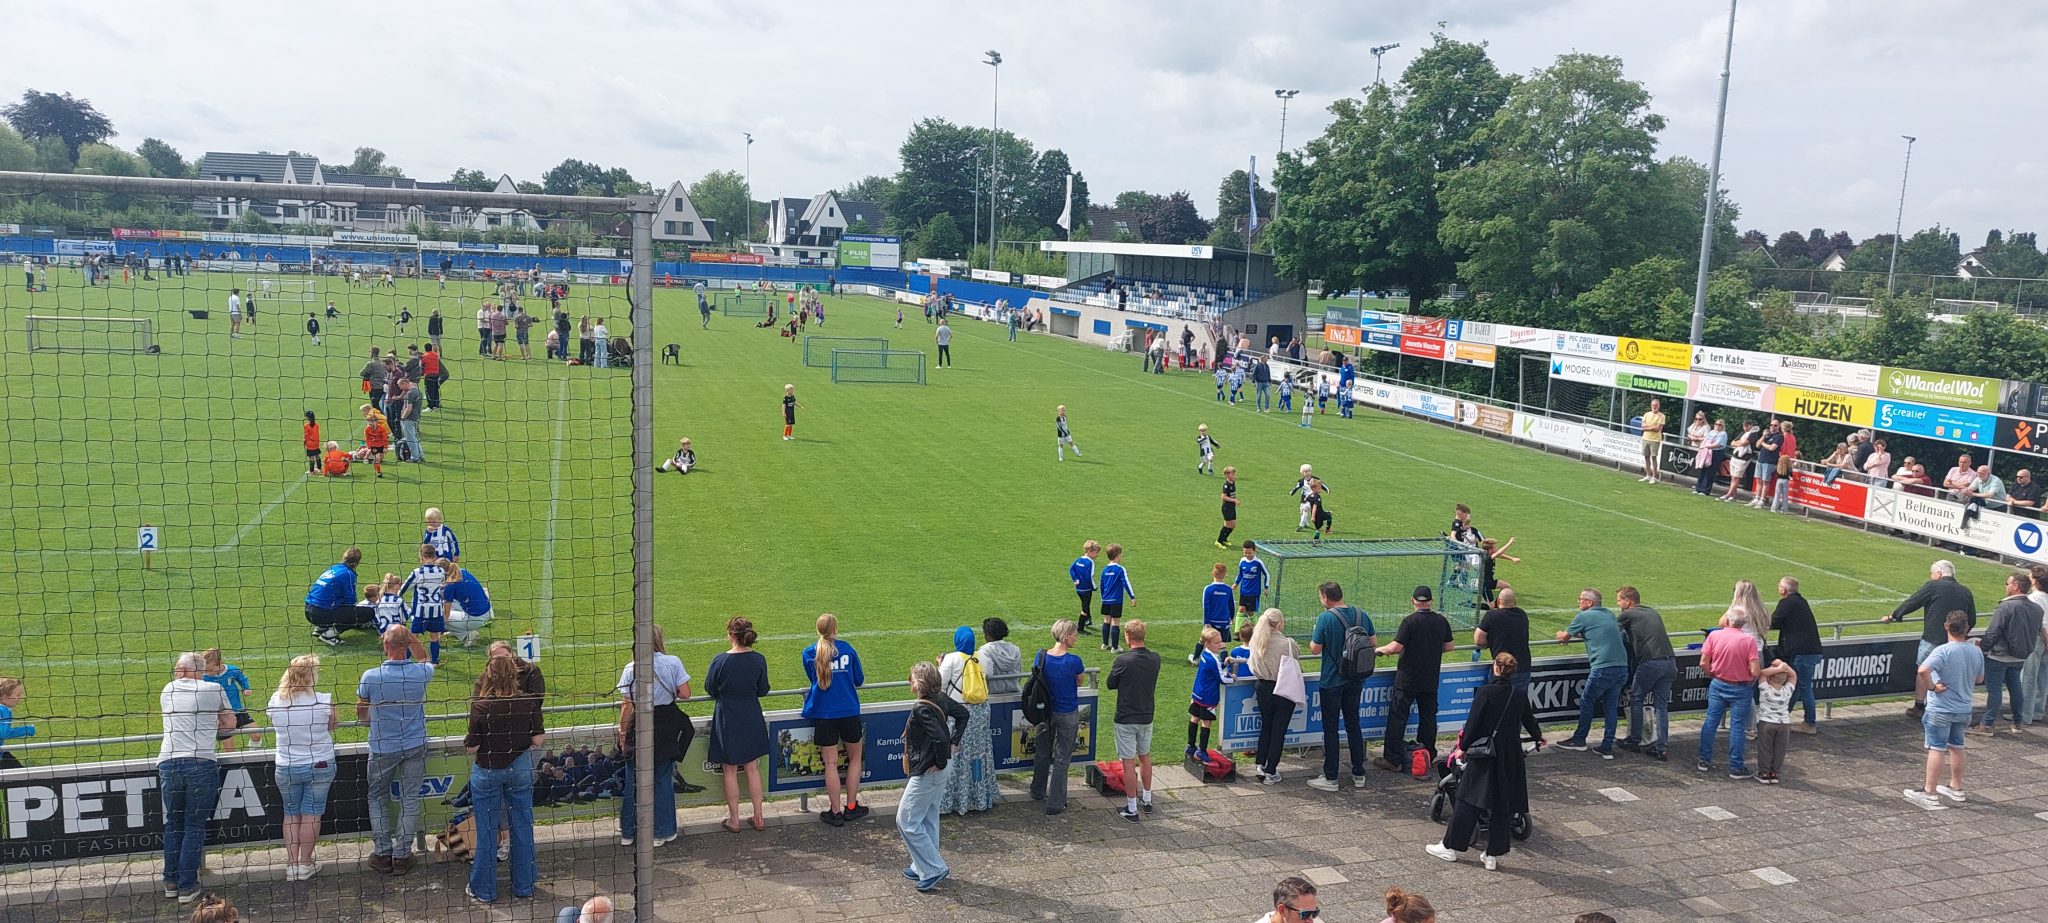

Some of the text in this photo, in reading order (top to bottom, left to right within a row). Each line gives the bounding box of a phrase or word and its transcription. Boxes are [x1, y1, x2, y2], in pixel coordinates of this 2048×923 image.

[340, 233, 411, 243] www.unionsv.nl
[544, 246, 571, 254] Ophoff
[1191, 246, 1202, 255] USV
[1329, 328, 1346, 342] ING
[1568, 334, 1599, 344] PEC ZWOLLE
[1600, 342, 1616, 351] USV
[1710, 352, 1745, 365] ten Kate
[1781, 356, 1817, 370] Kalshoven
[1564, 364, 1613, 378] MOORE MKW
[1633, 376, 1669, 391] BRASJEN
[1904, 374, 1986, 398] WandelWol
[1376, 389, 1391, 399] USV
[1700, 382, 1756, 400] INTERSHADES
[1802, 390, 1847, 403] LOONBEDRIJF
[1420, 394, 1433, 403] VAST
[1421, 402, 1439, 413] BOUW
[1794, 397, 1853, 422] HUZEN
[1538, 418, 1571, 435] kuiper
[1904, 498, 1956, 520] Beltman's
[1898, 511, 1960, 537] Woodworks
[142, 533, 154, 548] 2
[418, 586, 442, 604] 36
[523, 641, 533, 660] 1
[1826, 653, 1894, 679] BOKHORST
[1527, 678, 1587, 710] KKI'S
[1001, 756, 1020, 766] 2023
[6, 768, 266, 839] PETA
[4, 845, 53, 860] HAIR
[77, 832, 166, 853] FASHION
